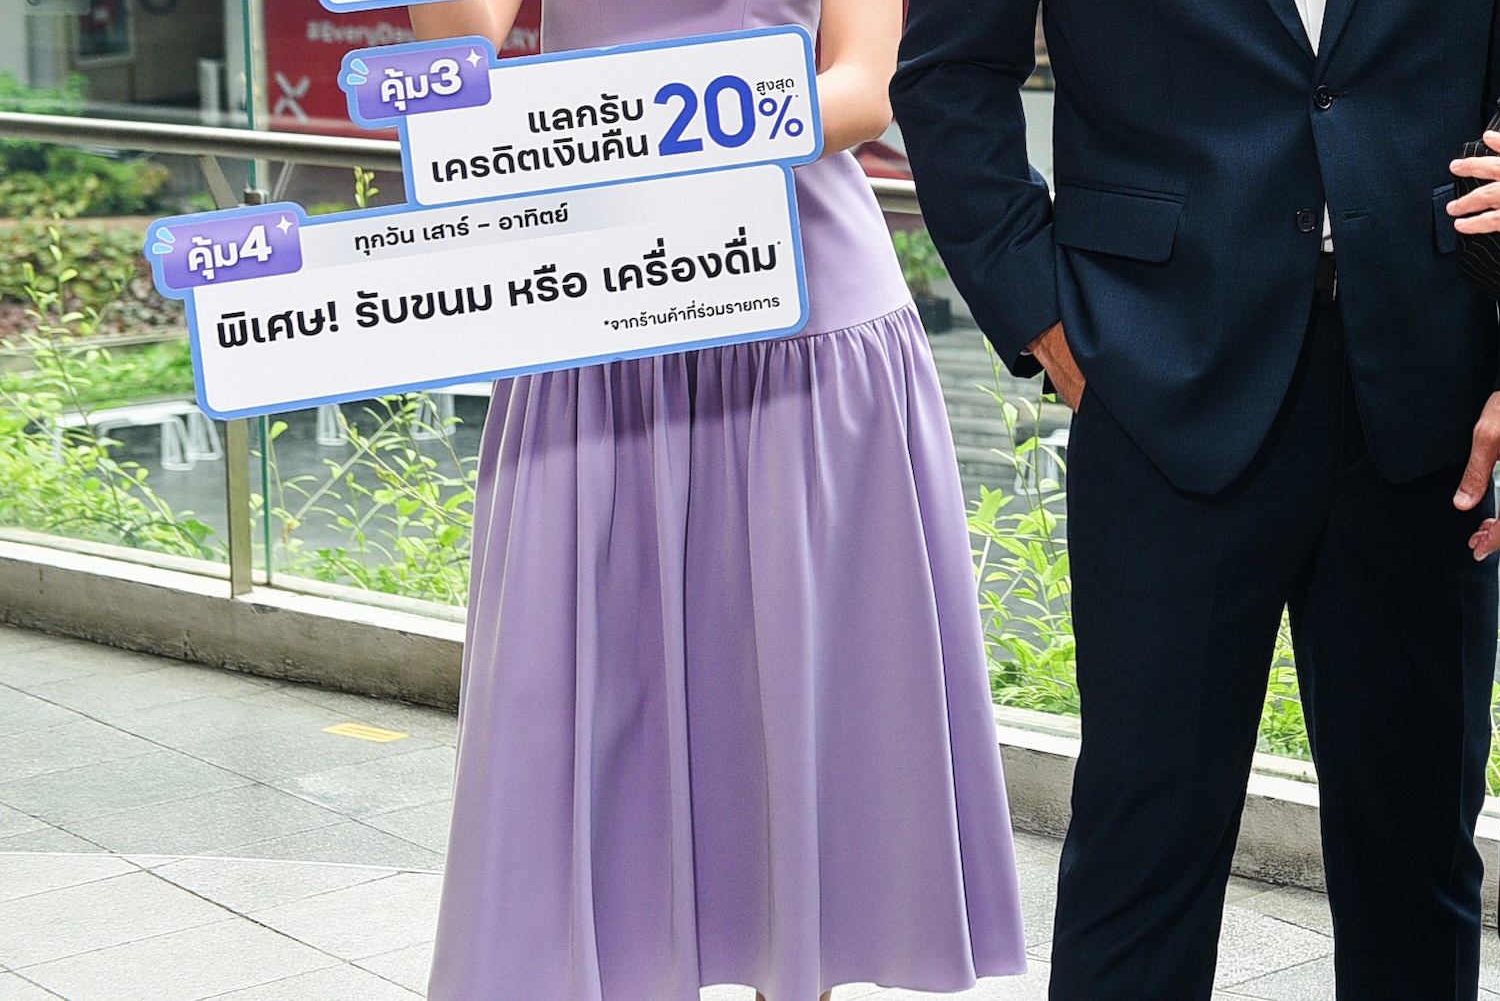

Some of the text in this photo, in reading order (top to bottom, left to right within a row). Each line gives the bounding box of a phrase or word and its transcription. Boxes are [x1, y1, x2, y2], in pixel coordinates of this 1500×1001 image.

[381, 58, 462, 110] คุ้ม3
[756, 78, 795, 96] สูงสุด
[527, 93, 644, 134] แลกรับ
[431, 130, 649, 183] เครดิตเงินคืน
[188, 224, 273, 281] คุ้ม4
[354, 226, 415, 256] ทุกวัน
[422, 215, 470, 241] เสาร์
[498, 202, 568, 231] อาทิตย์
[216, 300, 339, 349] พิเศษ!
[355, 284, 493, 328] รับขนม
[507, 263, 588, 307] หรือ
